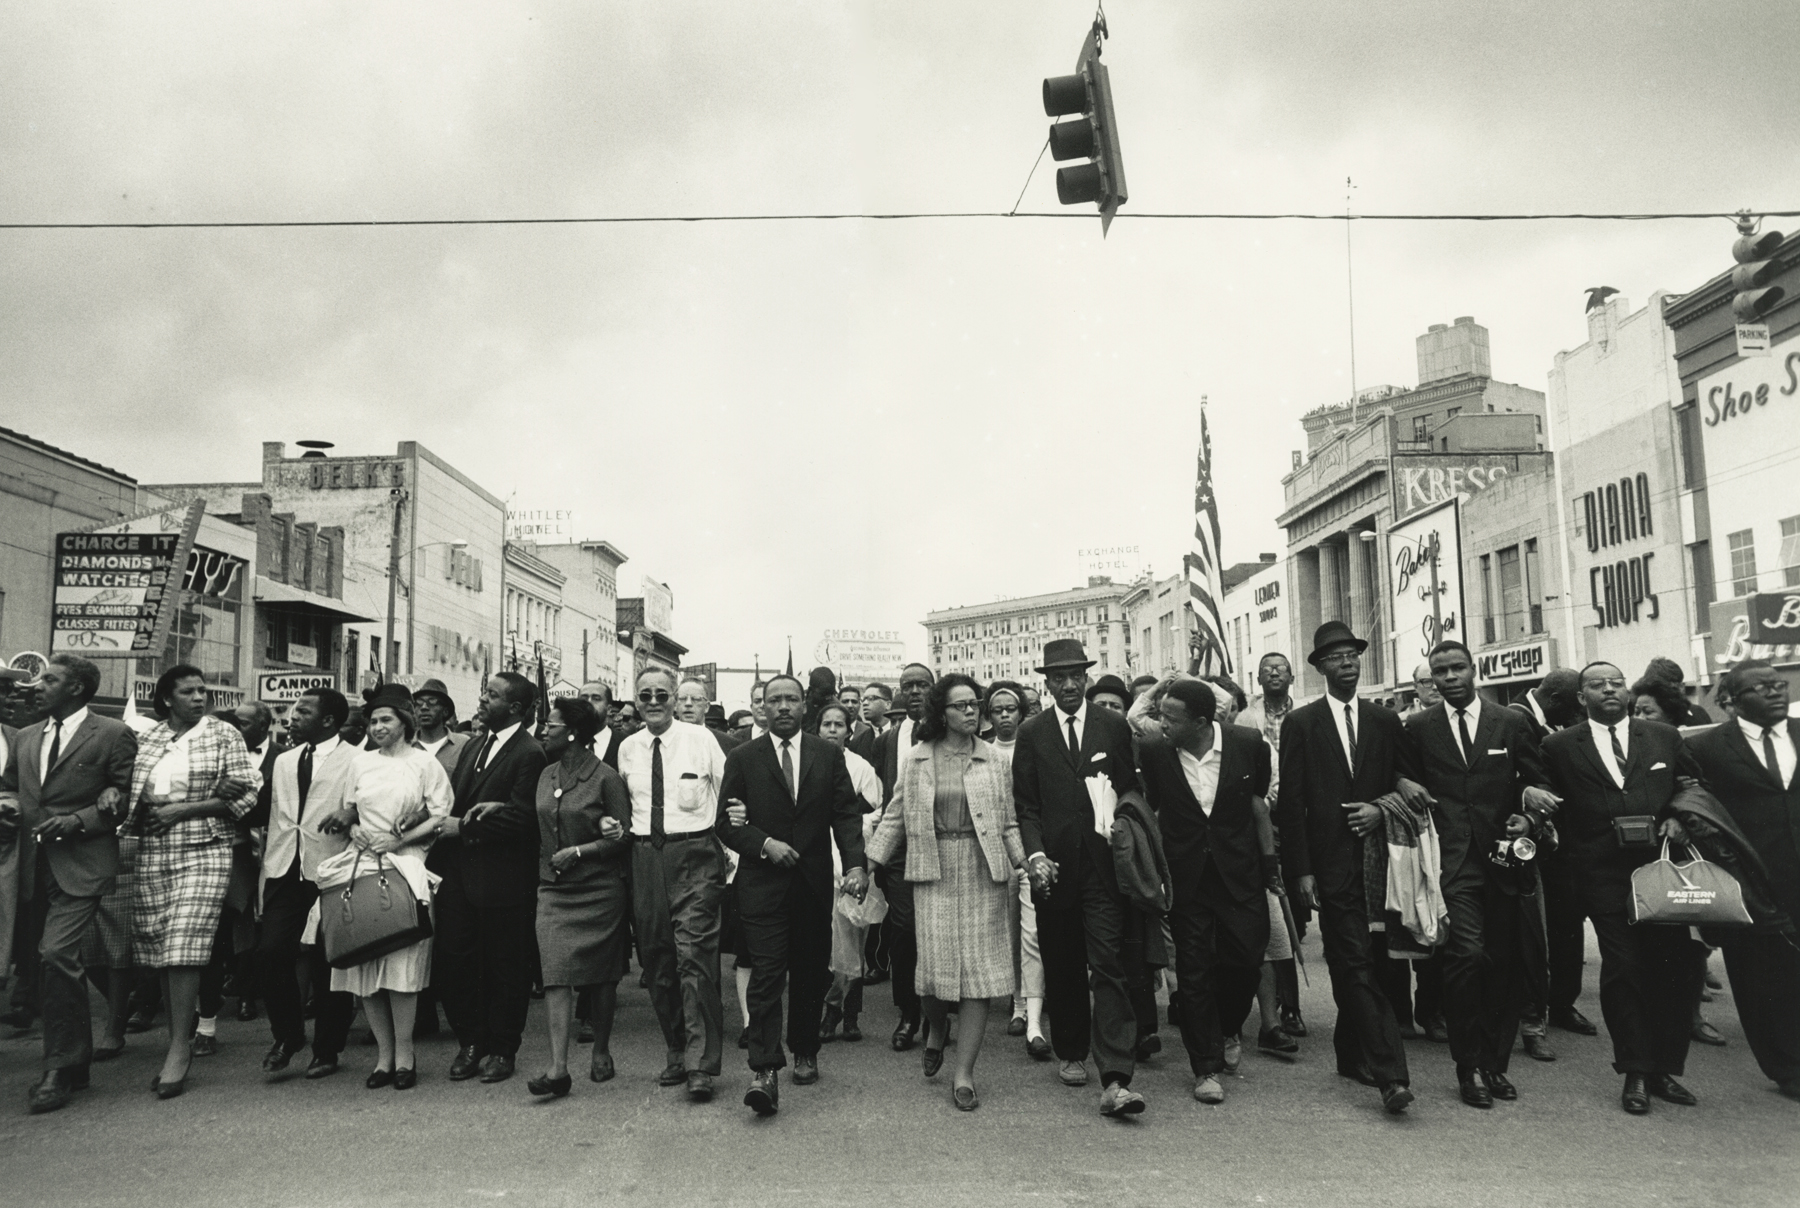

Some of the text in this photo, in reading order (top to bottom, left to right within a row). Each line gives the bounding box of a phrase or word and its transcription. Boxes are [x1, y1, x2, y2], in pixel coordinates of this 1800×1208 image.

[1738, 329, 1768, 341] PARKING
[1705, 381, 1770, 427] Shoe
[506, 510, 572, 520] WHITLEY
[1583, 471, 1653, 553] DIANA
[62, 536, 174, 550] CHARGE IT
[1078, 545, 1140, 557] EXCHANGE
[61, 556, 152, 569] DIAMONDS
[1089, 560, 1128, 569] HOTEL
[62, 573, 150, 587] WATCHES
[1589, 552, 1660, 629] SHOPS
[85, 604, 138, 616] EXAMINED
[102, 618, 138, 630] FITTED
[823, 629, 900, 640] CHEVROLET
[1478, 646, 1543, 681] MY SHOP
[266, 677, 332, 692] CANNON
[135, 682, 157, 701] AP
[548, 689, 576, 697] HOUSE
[1667, 890, 1717, 898] EASTERN
